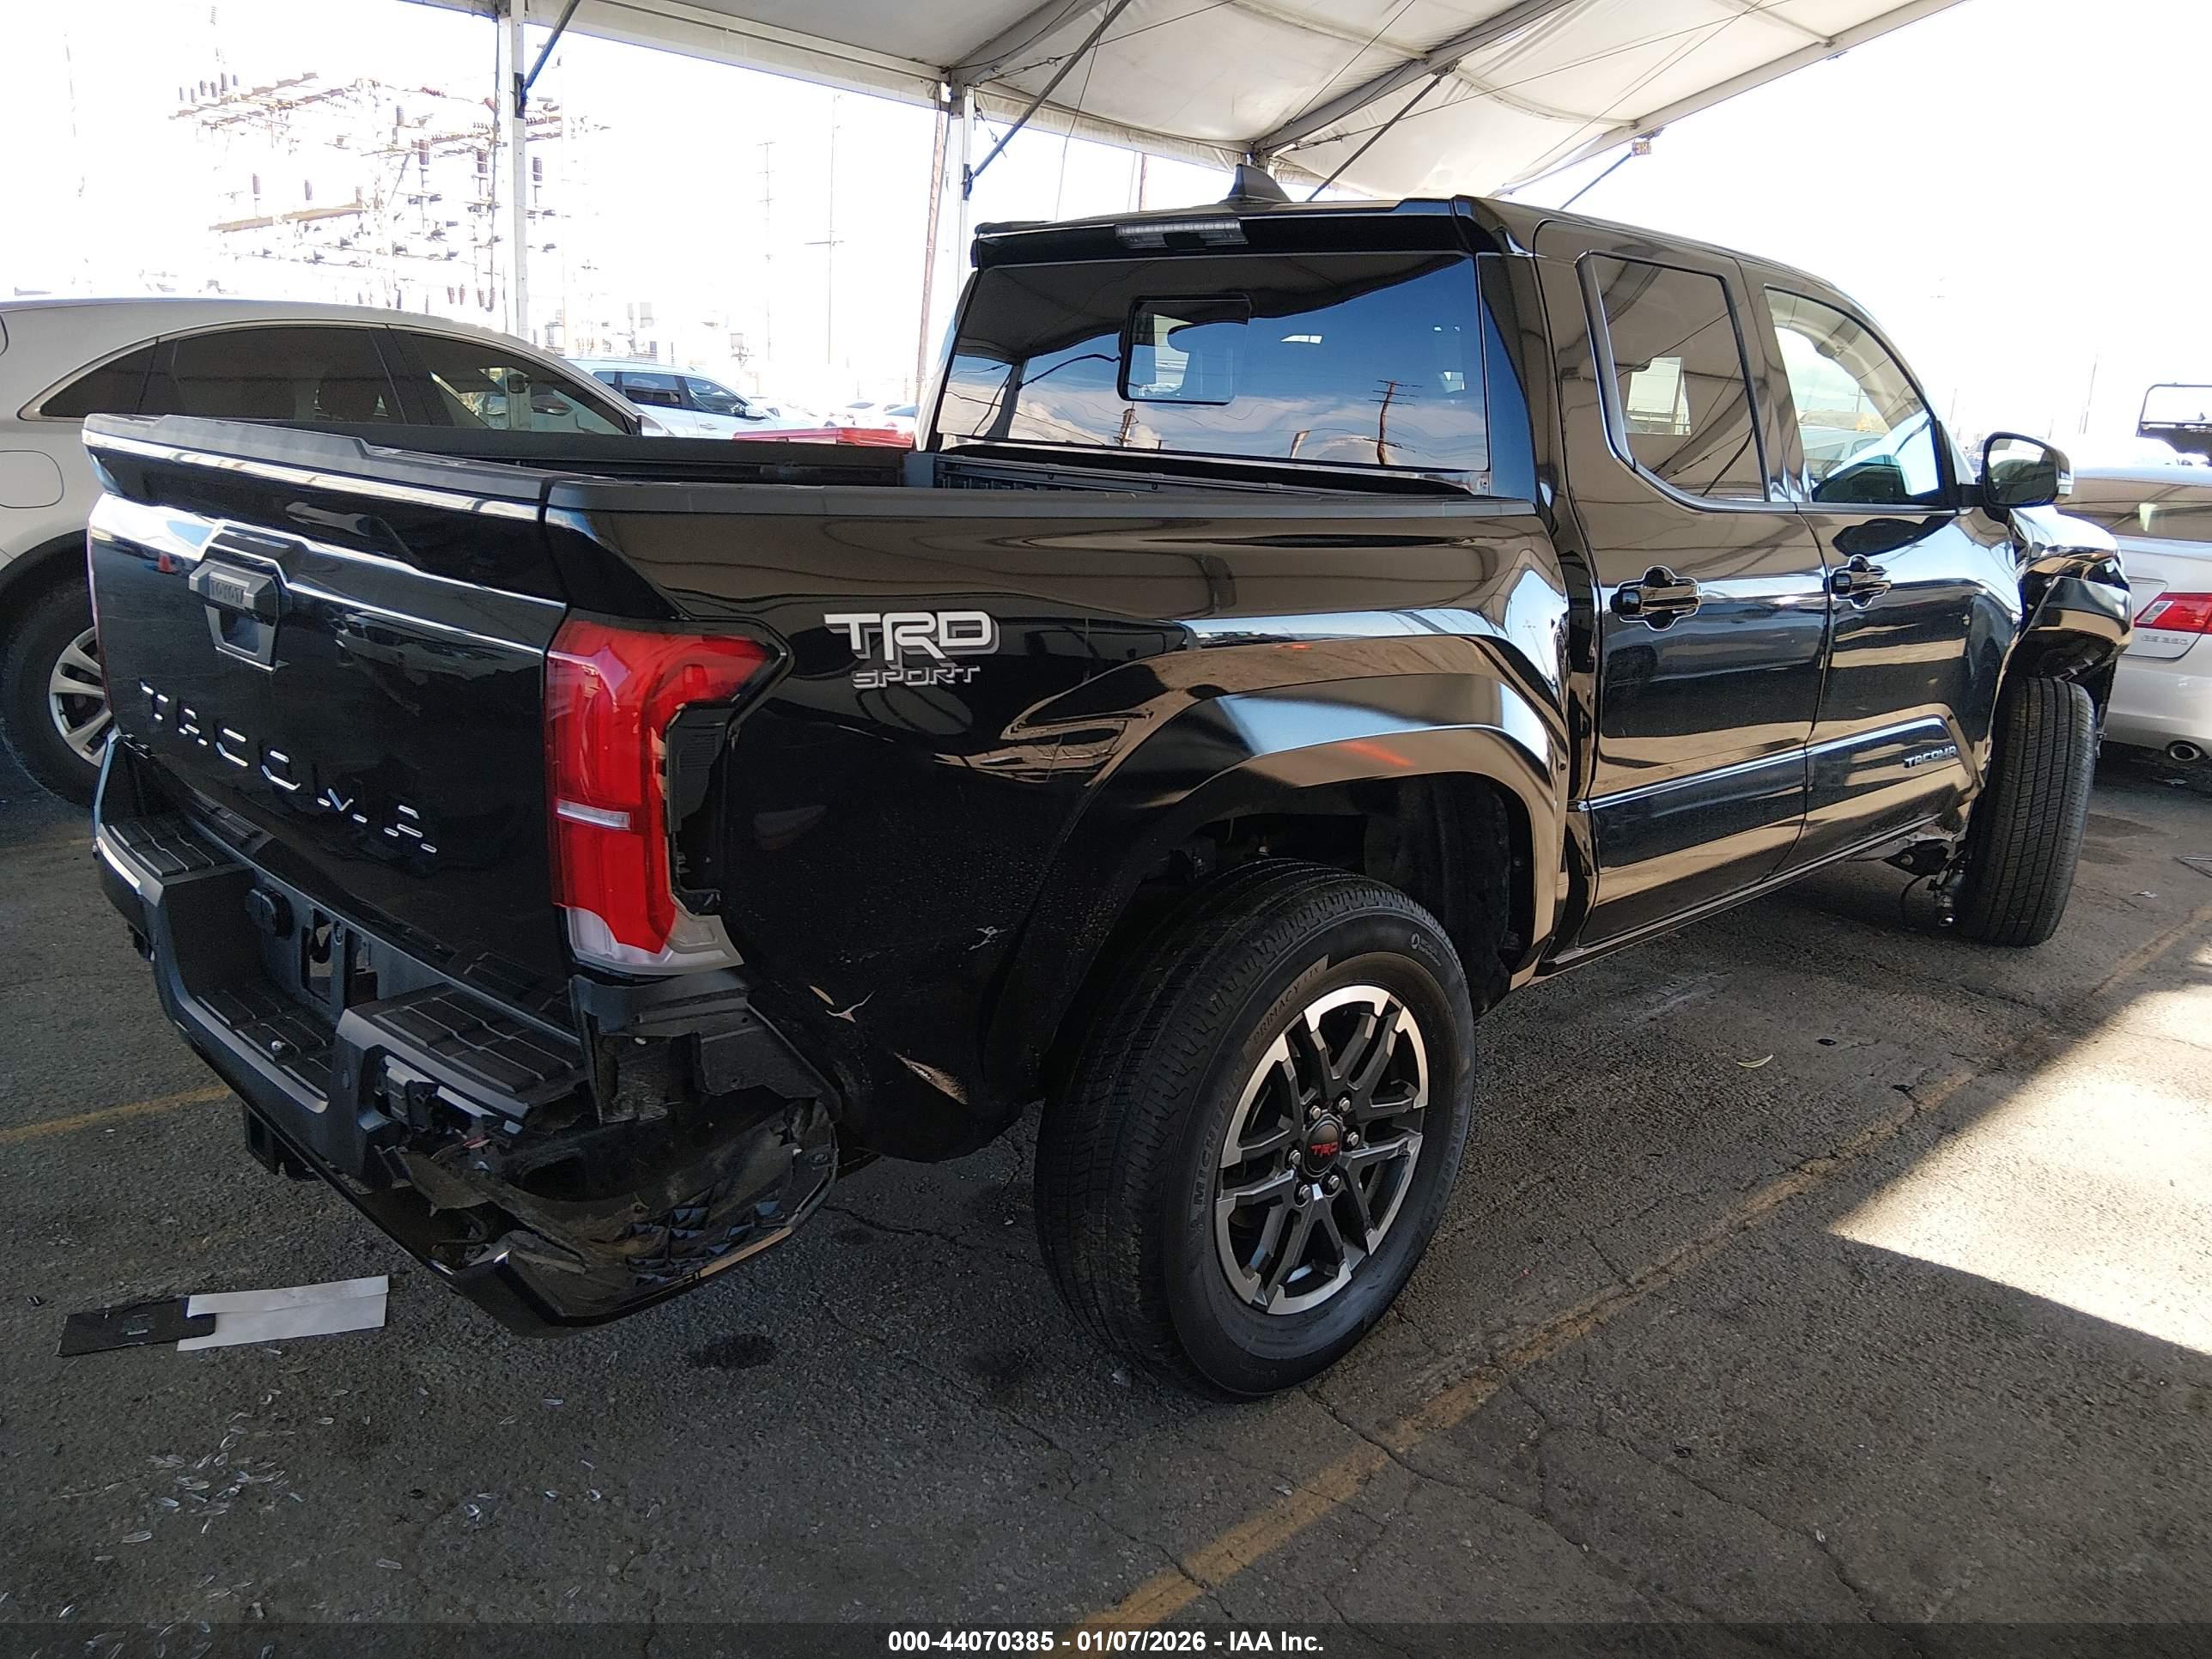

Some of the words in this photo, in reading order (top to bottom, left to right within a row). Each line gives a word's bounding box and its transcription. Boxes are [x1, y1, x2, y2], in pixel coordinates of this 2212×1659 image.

[824, 611, 1000, 667] TRD
[852, 665, 981, 690] SPORT
[140, 682, 437, 853] TACOMA
[1904, 745, 1957, 769] TACOMA
[1251, 981, 1300, 1044] PRIMACY
[1311, 1141, 1339, 1158] TRD
